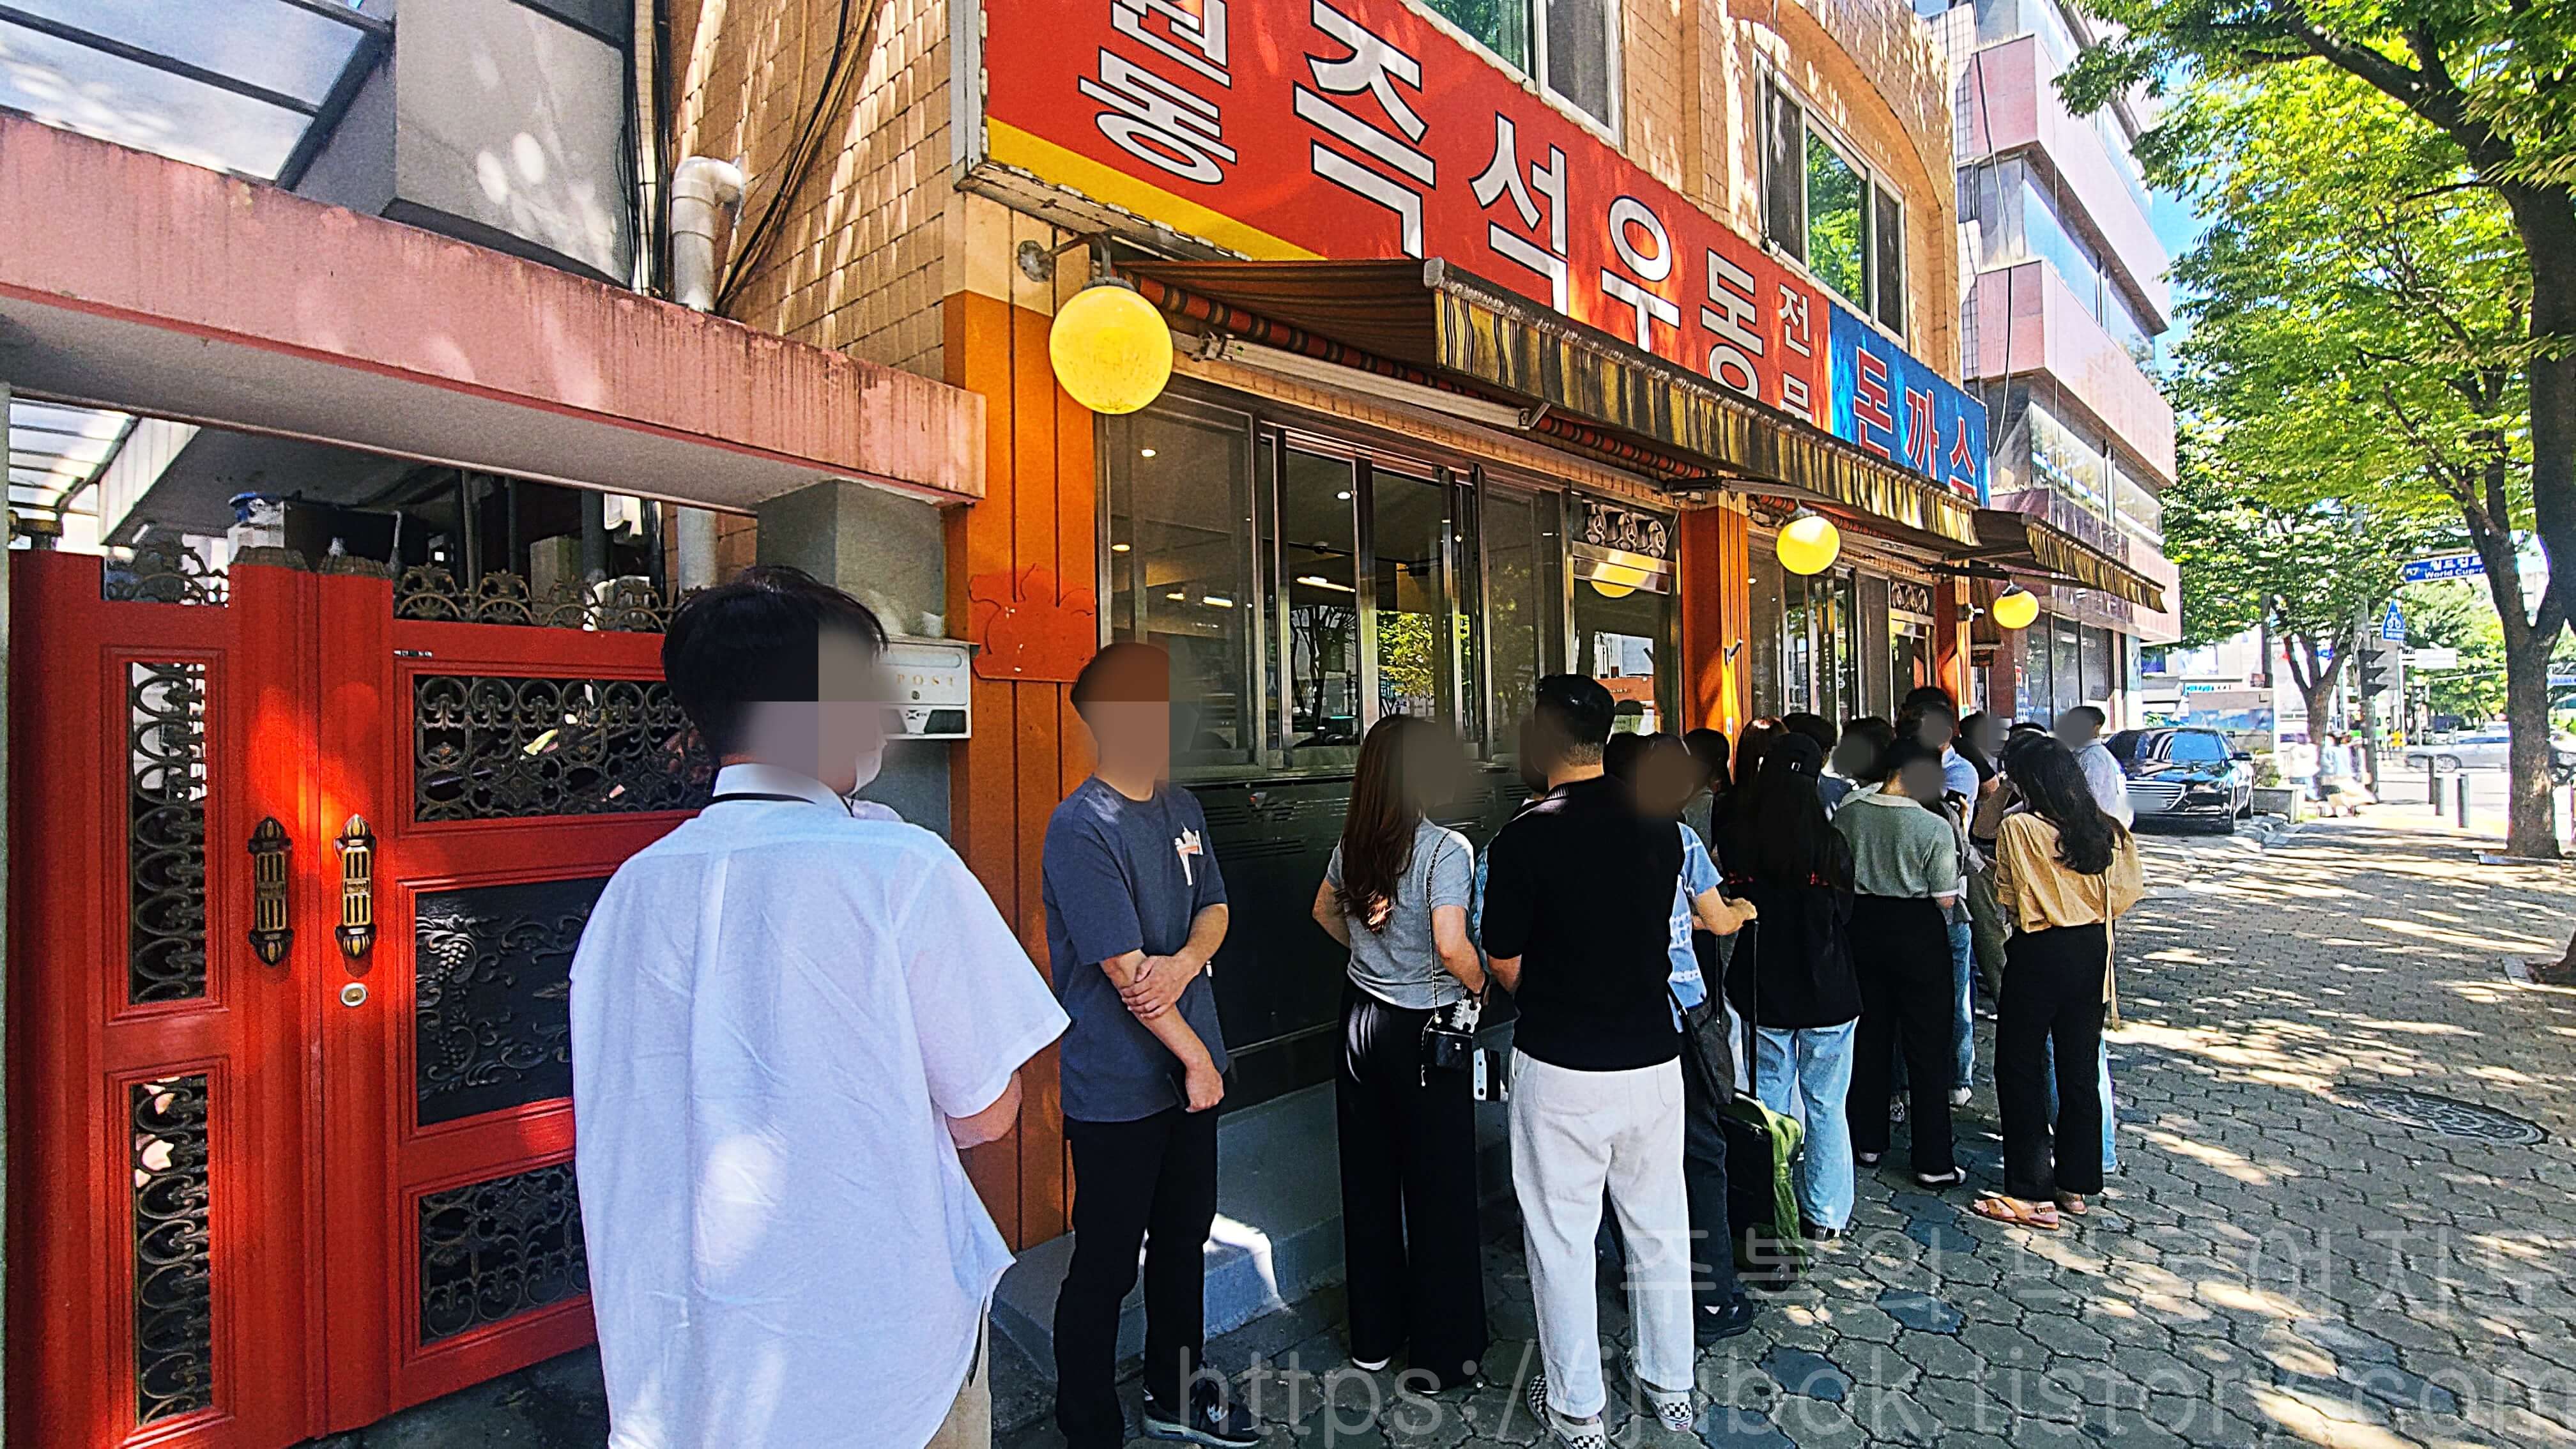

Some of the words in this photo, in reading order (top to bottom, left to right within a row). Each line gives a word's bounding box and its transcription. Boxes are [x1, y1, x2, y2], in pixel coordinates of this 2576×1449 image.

[1853, 346, 1979, 500] 돈까스
[2425, 569, 2453, 578] World
[2455, 567, 2485, 576] Cup-r
[896, 673, 954, 686] POST
